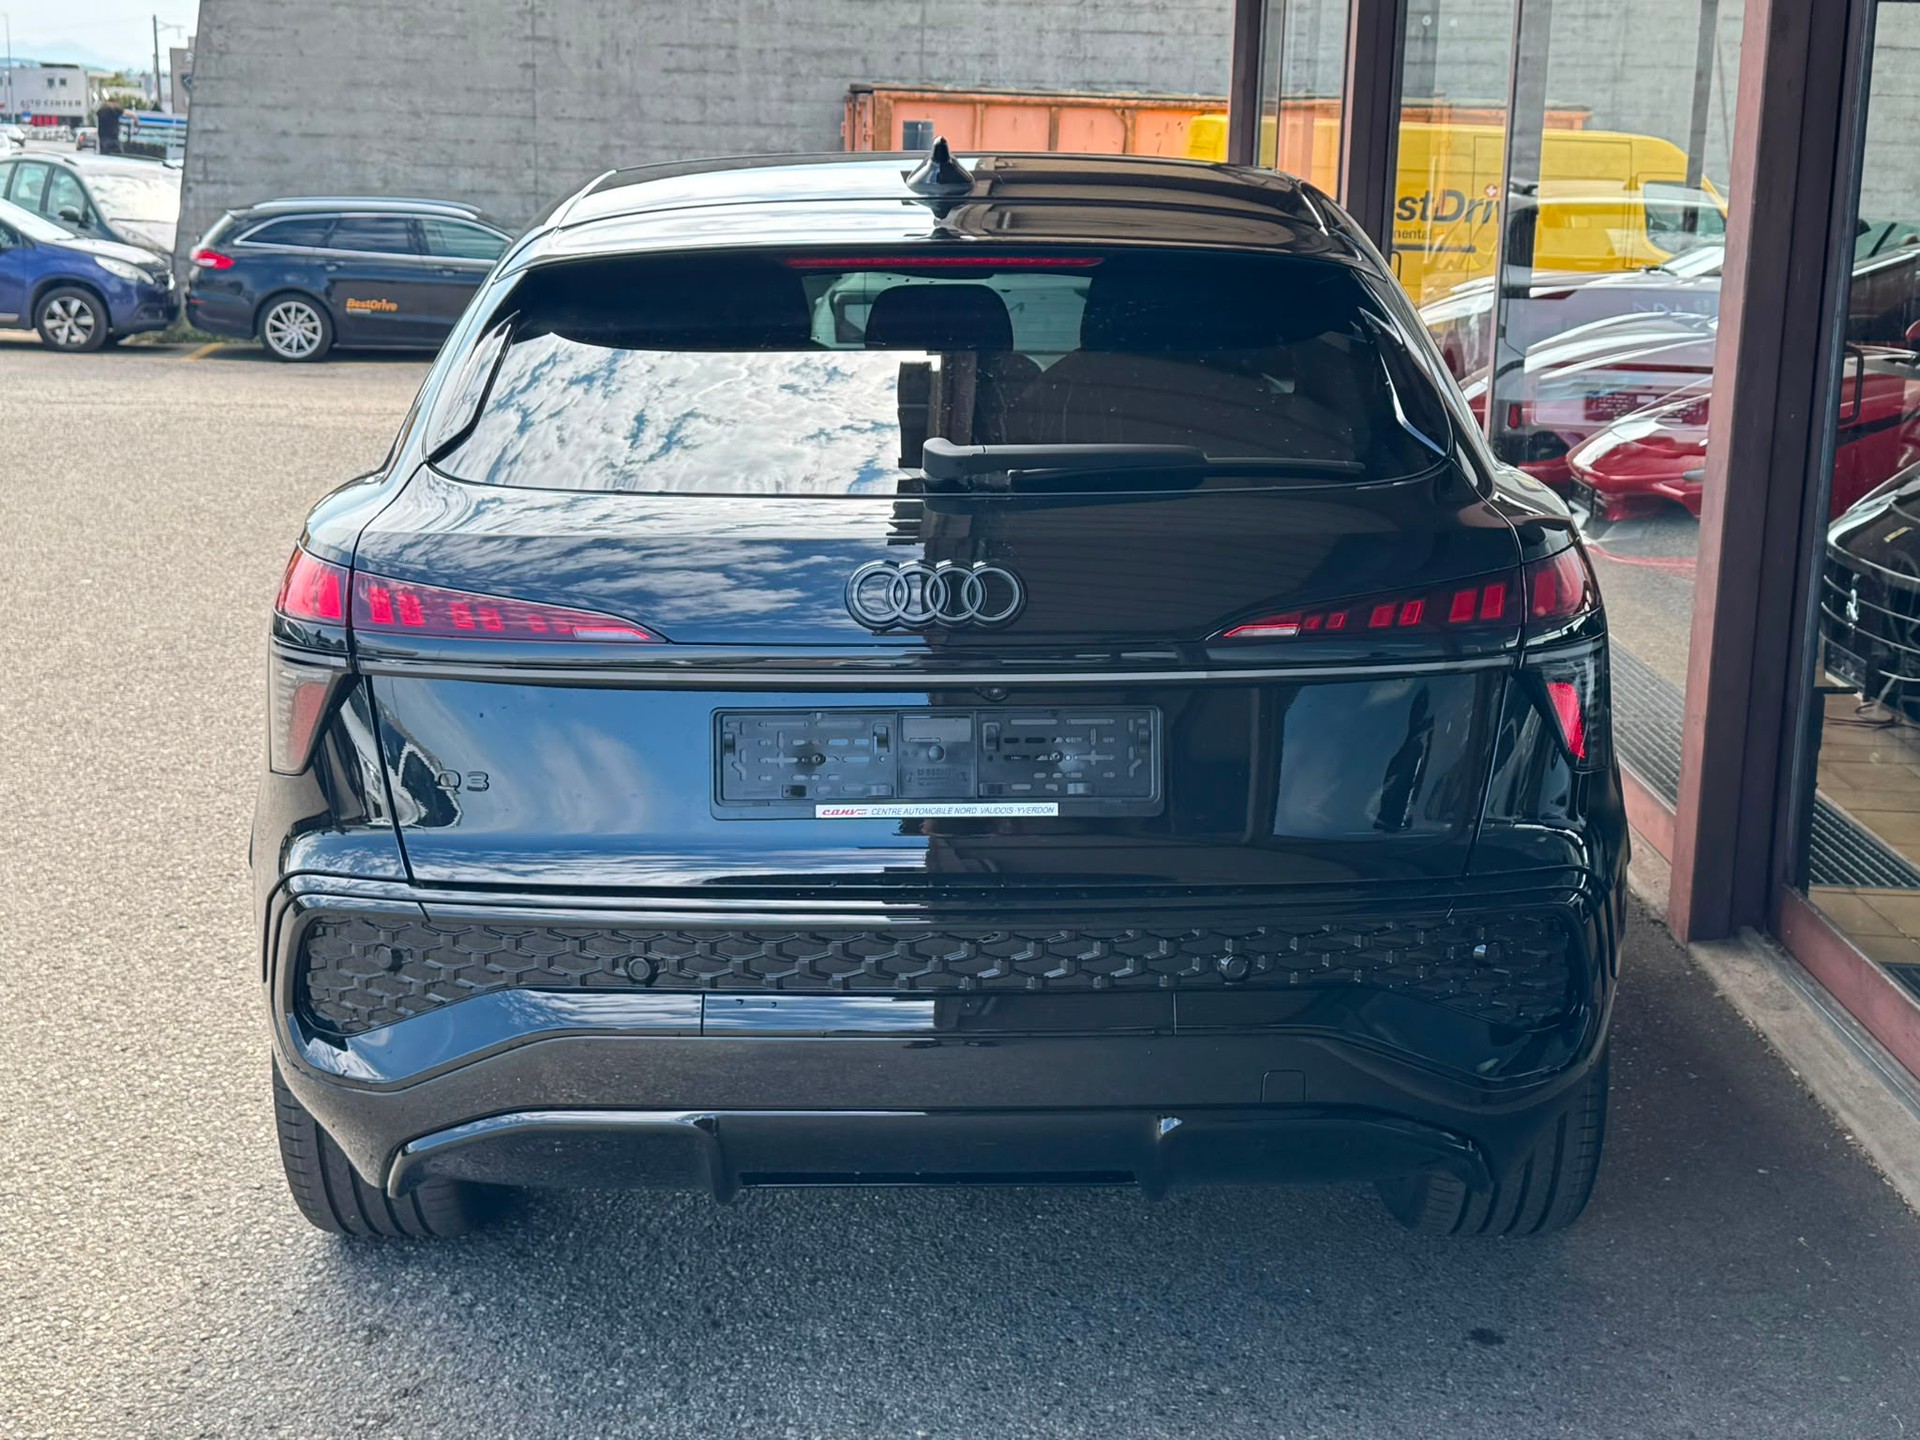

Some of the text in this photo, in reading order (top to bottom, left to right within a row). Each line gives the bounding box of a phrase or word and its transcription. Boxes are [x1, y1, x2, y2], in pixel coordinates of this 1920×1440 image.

[346, 298, 398, 312] BestDrive
[438, 769, 490, 794] Q3
[871, 807, 901, 816] CENTRE
[903, 806, 953, 816] AUTOMOBILE
[954, 806, 978, 815] NORD
